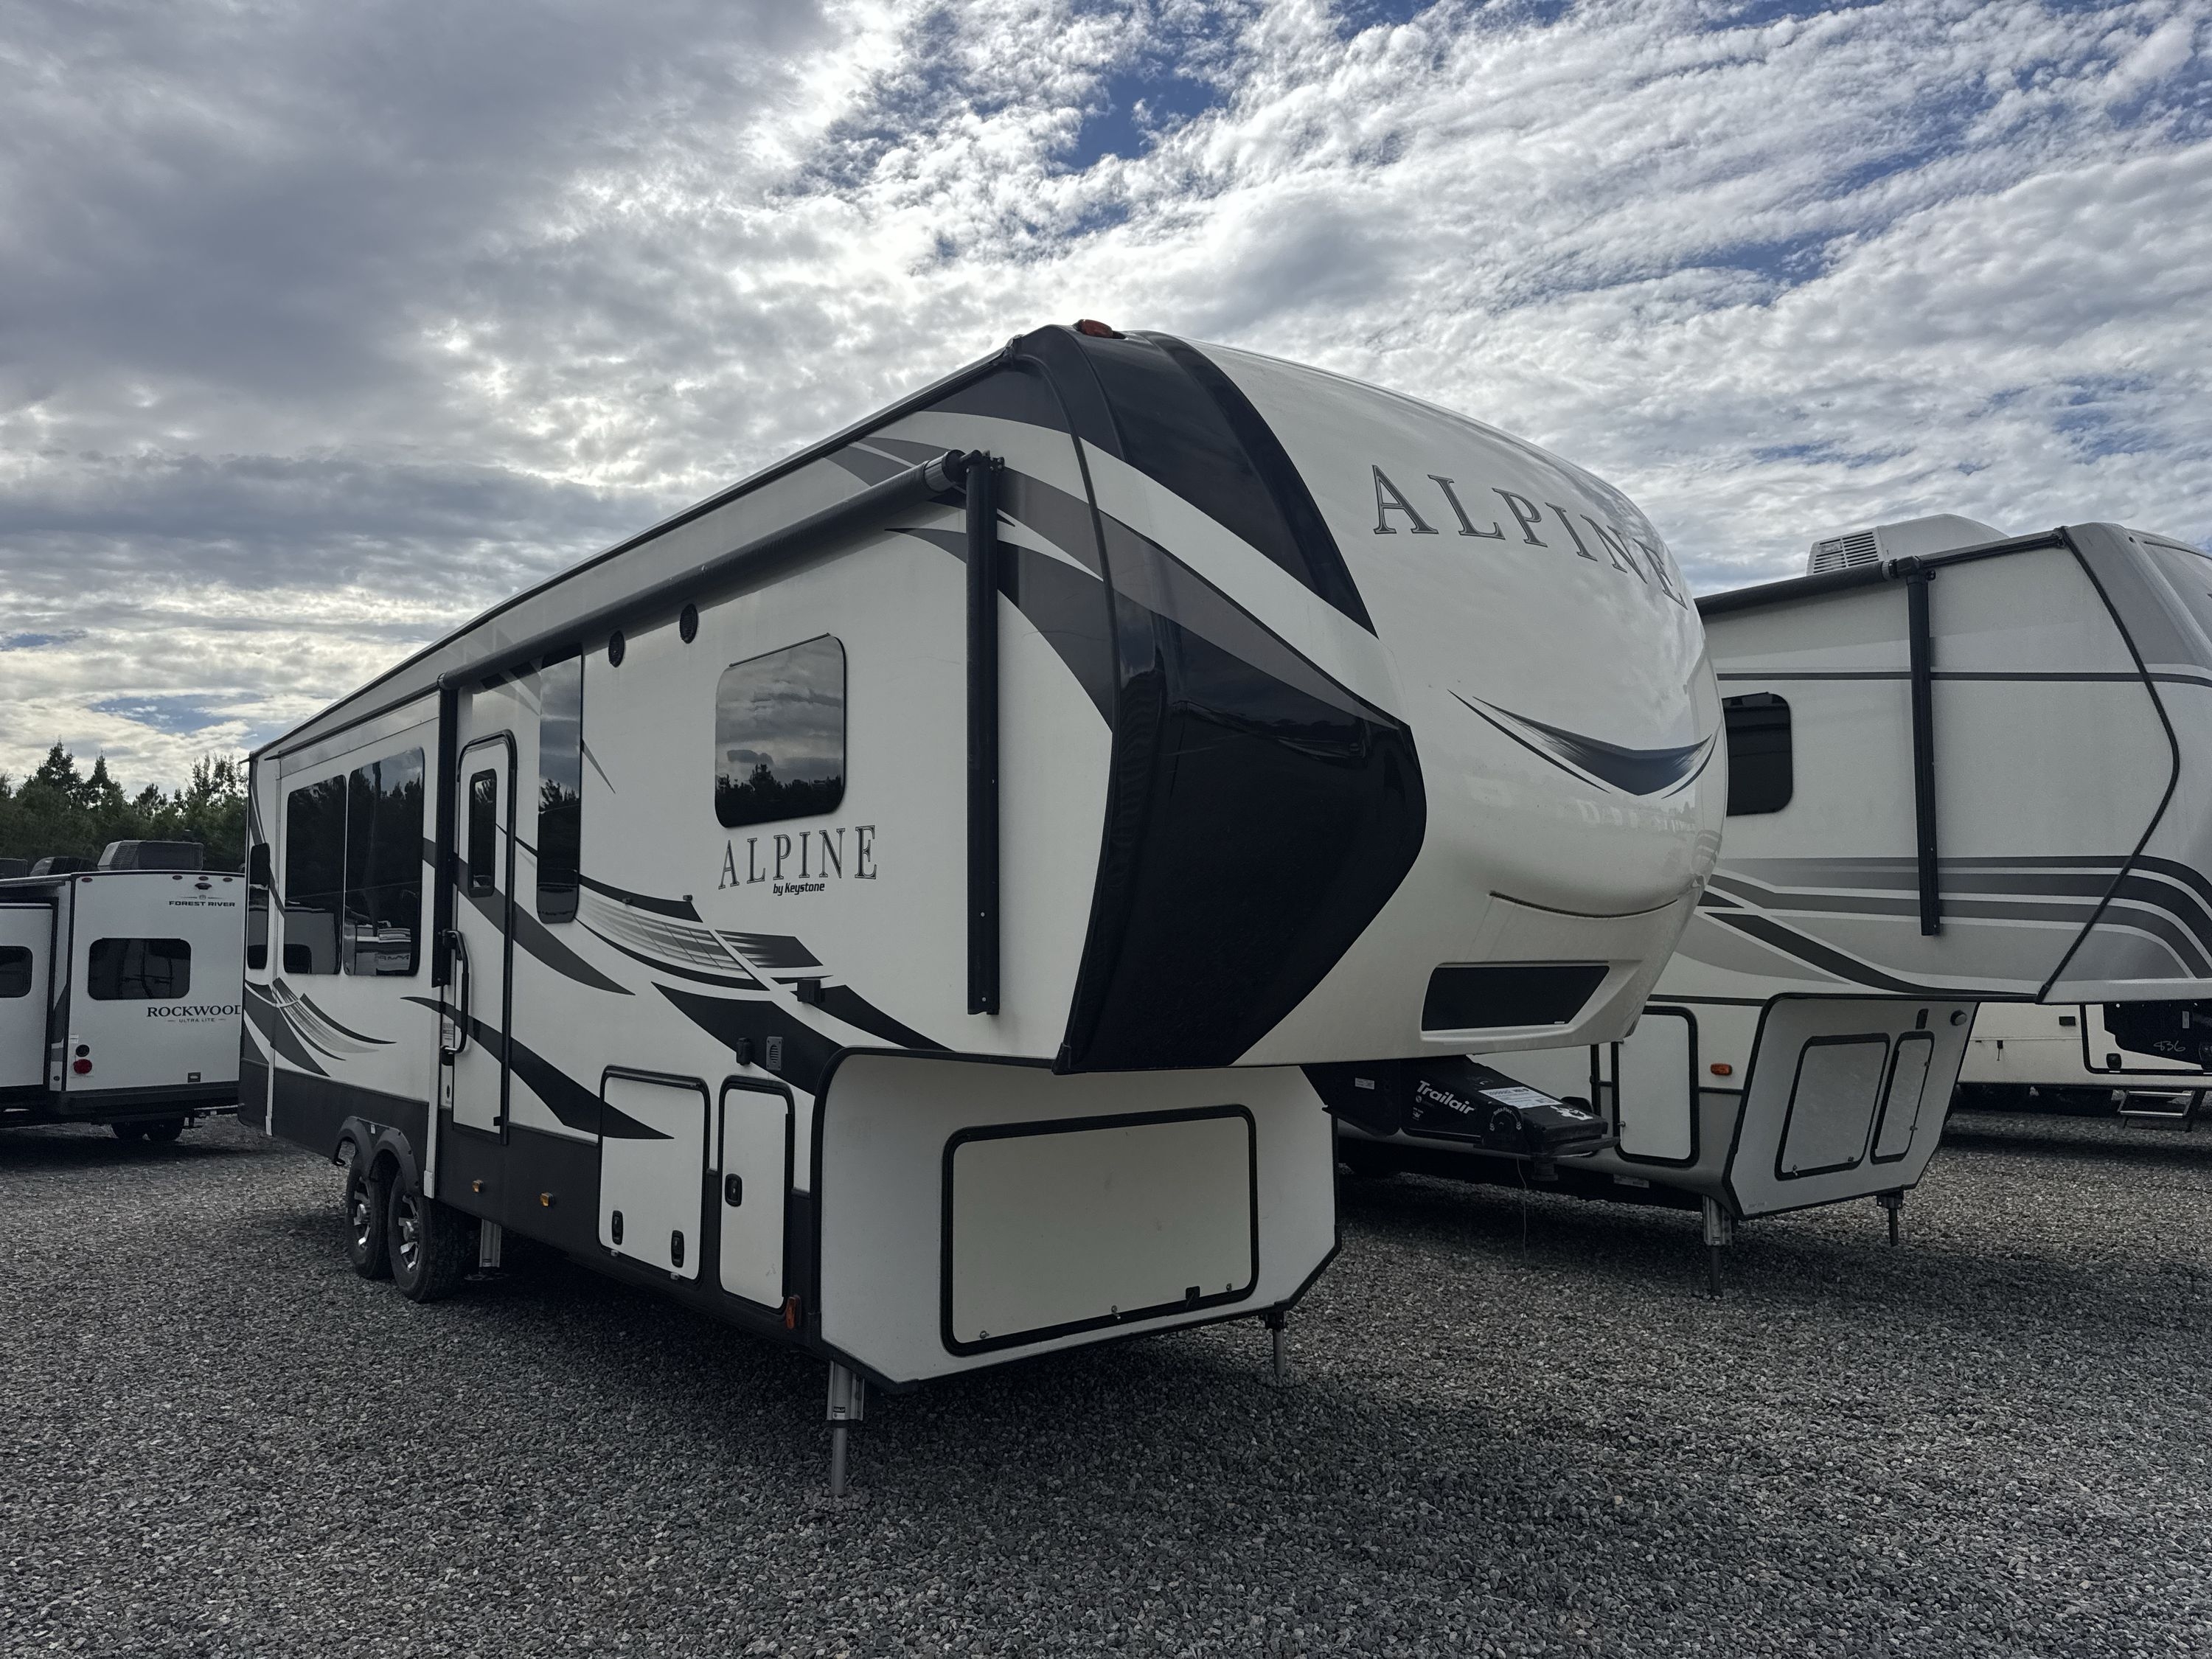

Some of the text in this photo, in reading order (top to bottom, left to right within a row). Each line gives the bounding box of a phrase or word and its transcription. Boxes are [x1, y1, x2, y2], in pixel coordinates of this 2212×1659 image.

[1371, 465, 1688, 611] ALPINE
[718, 824, 877, 890] ALPINE
[773, 882, 825, 896] by Keystone
[1416, 1079, 1475, 1115] Trailair
